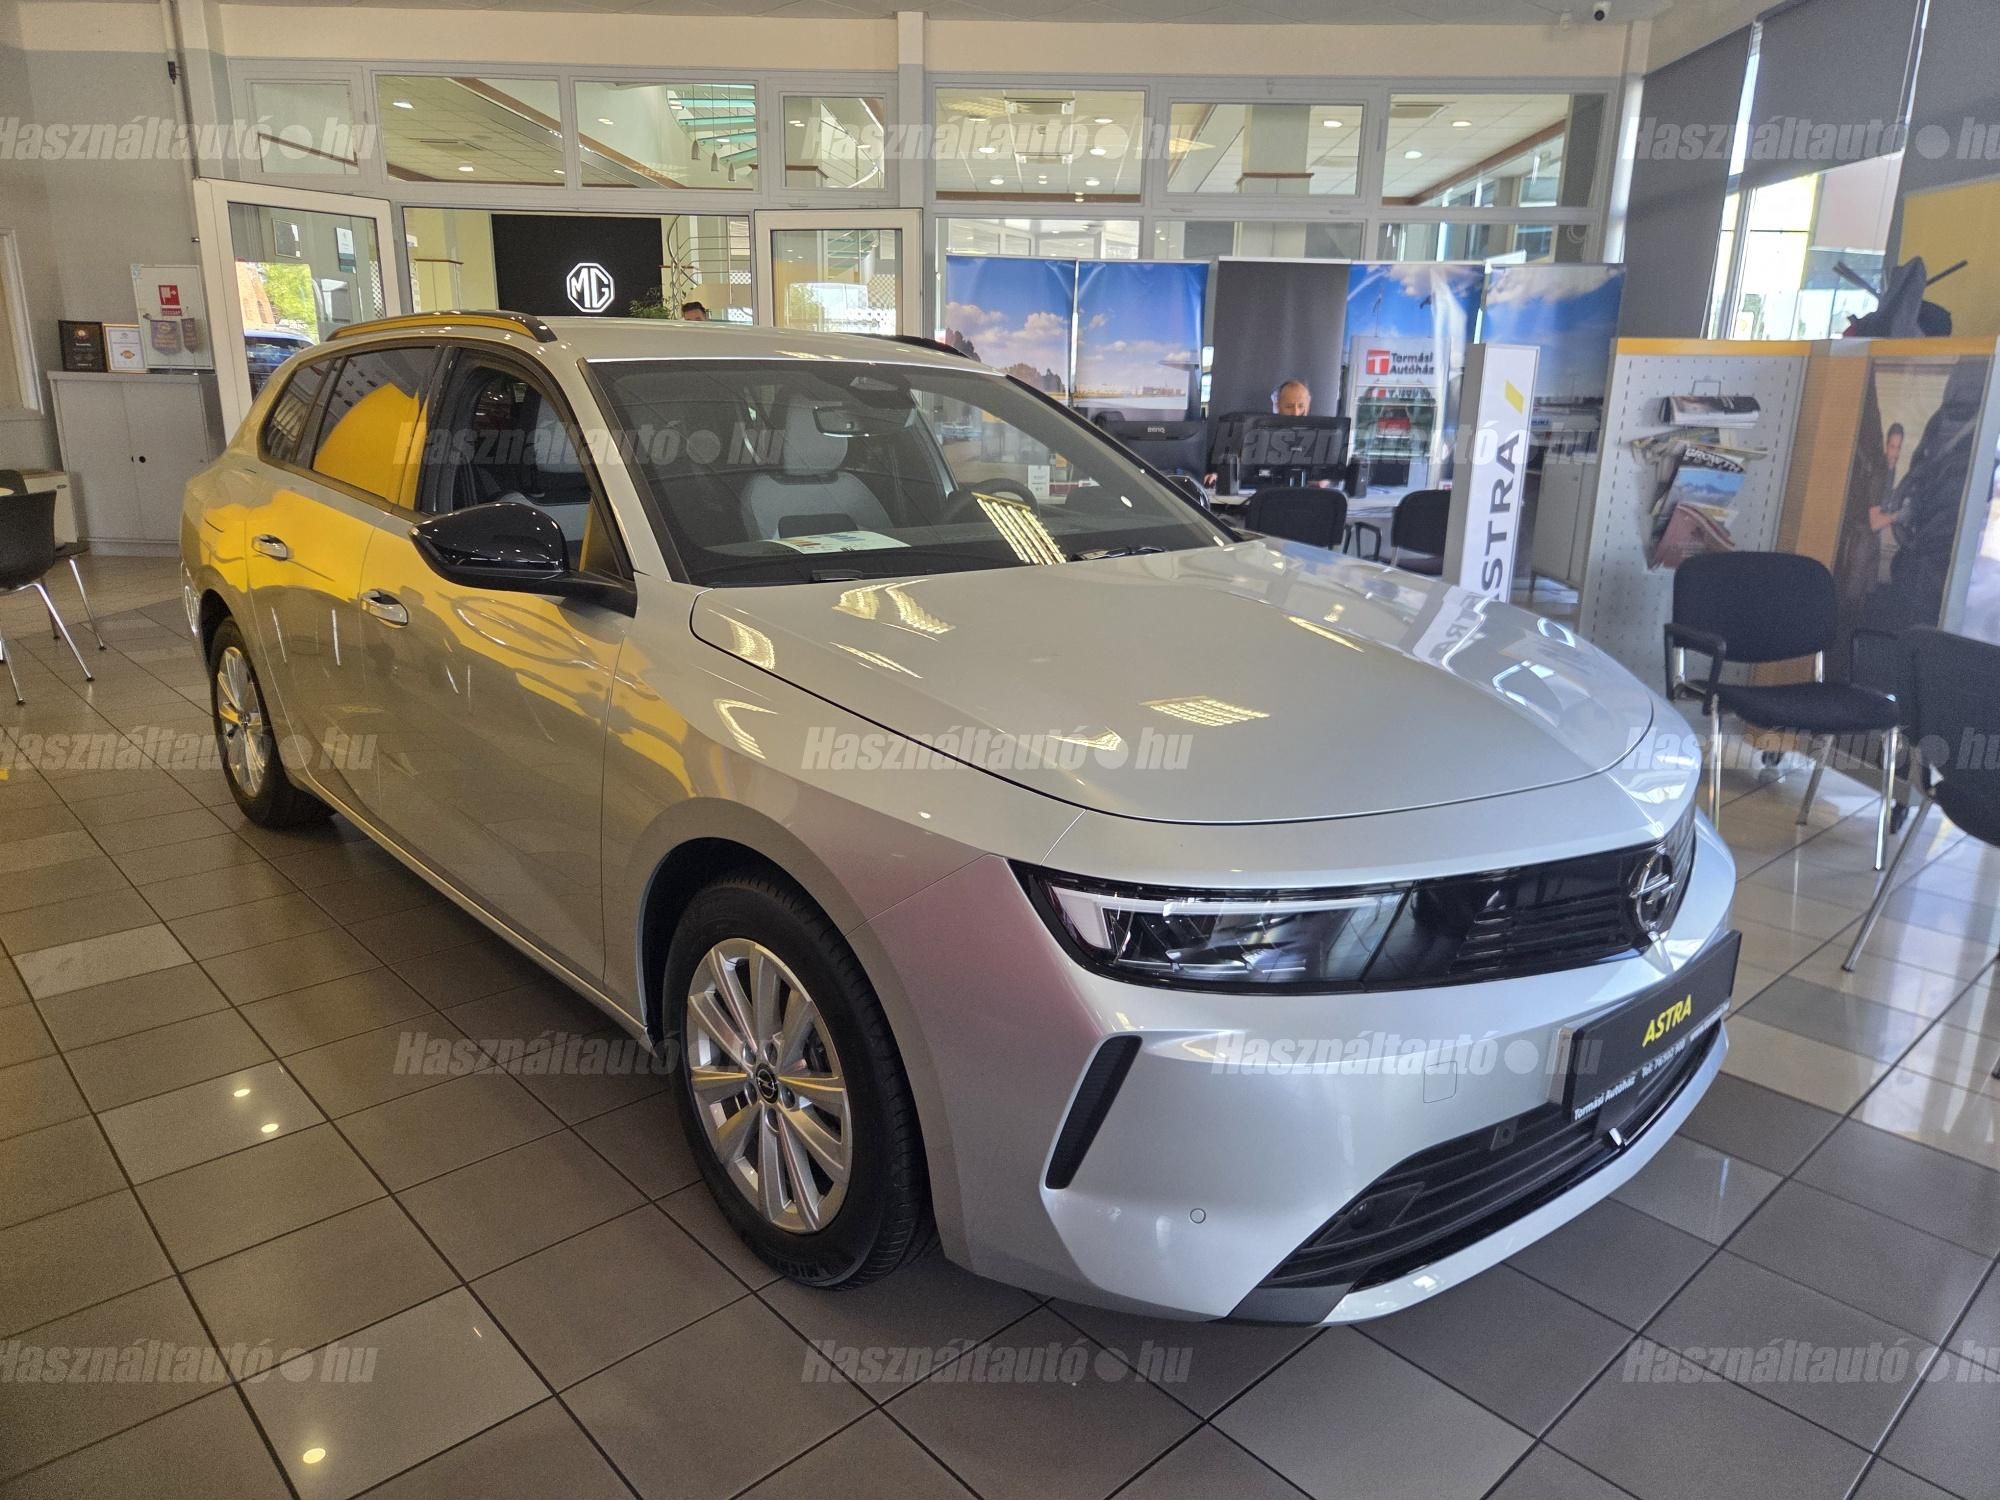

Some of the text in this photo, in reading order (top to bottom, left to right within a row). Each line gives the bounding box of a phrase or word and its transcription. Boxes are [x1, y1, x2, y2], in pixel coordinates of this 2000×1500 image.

[570, 267, 610, 309] MG
[1391, 364, 1435, 375] Autóház
[1481, 432, 1520, 600] STRA
[1642, 994, 1692, 1048] ASTRA
[1574, 1092, 1604, 1121] Tormási
[1605, 1071, 1637, 1102] Autóház
